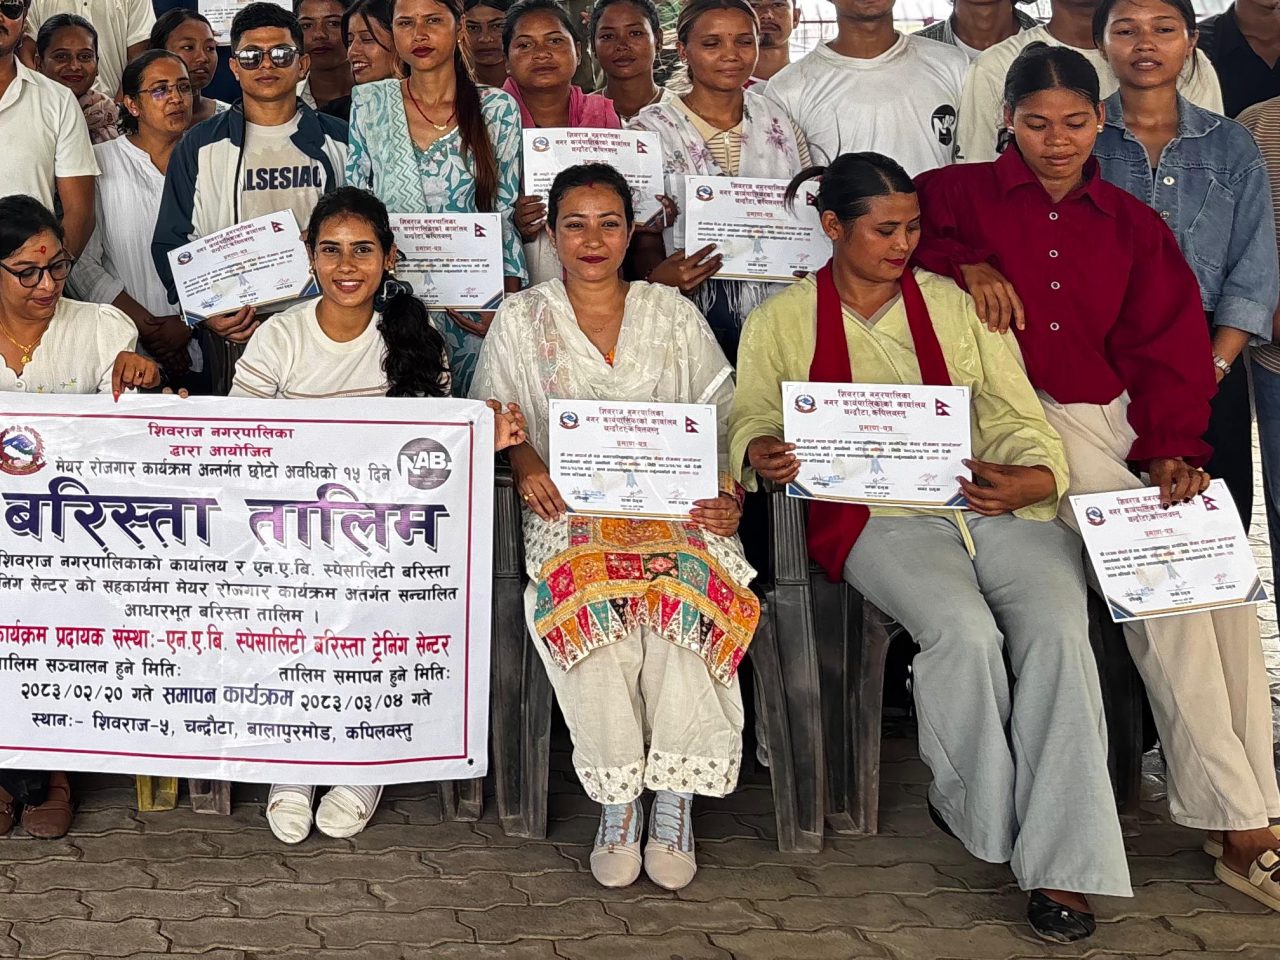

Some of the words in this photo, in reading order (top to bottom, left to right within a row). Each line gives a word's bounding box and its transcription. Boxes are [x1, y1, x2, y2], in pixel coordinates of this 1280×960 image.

[148, 422, 204, 437] शिवराज
[211, 424, 295, 440] नगरपालिका
[170, 444, 201, 457] द्वारा
[210, 443, 273, 457] आयोजित
[56, 457, 84, 476] मेयर
[89, 457, 136, 477] रोजगार
[142, 458, 193, 476] कार्यक्रम
[199, 459, 242, 478] अन्तर्गत
[247, 461, 279, 479] छोटो
[285, 461, 338, 480] अवधिको
[344, 467, 361, 483] १५
[368, 462, 391, 483] दिने
[1, 476, 222, 552] बरिस्ता
[244, 482, 450, 557] तालिम
[60, 552, 162, 573] नगरपालिकाको
[170, 555, 228, 574] कार्यालय
[235, 560, 246, 575] र
[323, 560, 395, 580] स्पेसालिटी
[401, 561, 451, 581] बरिस्ता
[31, 574, 69, 594] सेन्टर
[75, 576, 97, 592] को
[102, 577, 169, 596] सहकार्यमा
[176, 578, 209, 597] मेयर
[215, 580, 271, 599] रोजगार
[277, 582, 338, 601] कार्यक्रम
[345, 583, 391, 602] अंतर्गत
[398, 583, 459, 602] सन्चालित
[124, 603, 192, 622] आधारभूत
[199, 602, 249, 621] बरिस्ता
[256, 604, 304, 623] तालिम
[55, 626, 106, 649] प्रदायक
[235, 627, 306, 655] स्पेसालिटी
[313, 628, 366, 660] बरिस्ता
[371, 630, 409, 664] ट्रेनिंग
[416, 631, 451, 658] सेन्टर
[45, 658, 109, 675] सञ्चालन
[115, 658, 136, 680] हुने
[278, 663, 326, 683] तालिम
[333, 670, 383, 685] समापन
[389, 666, 408, 688] हुने
[21, 682, 123, 703] २०८३/०२/२०
[131, 684, 154, 702] गते
[162, 686, 217, 705] समापन
[222, 682, 294, 707] कार्यक्रम
[301, 693, 403, 713] २०८३/०३/०४
[411, 689, 433, 706] गते
[345, 721, 414, 742] कपिलवस्तु
